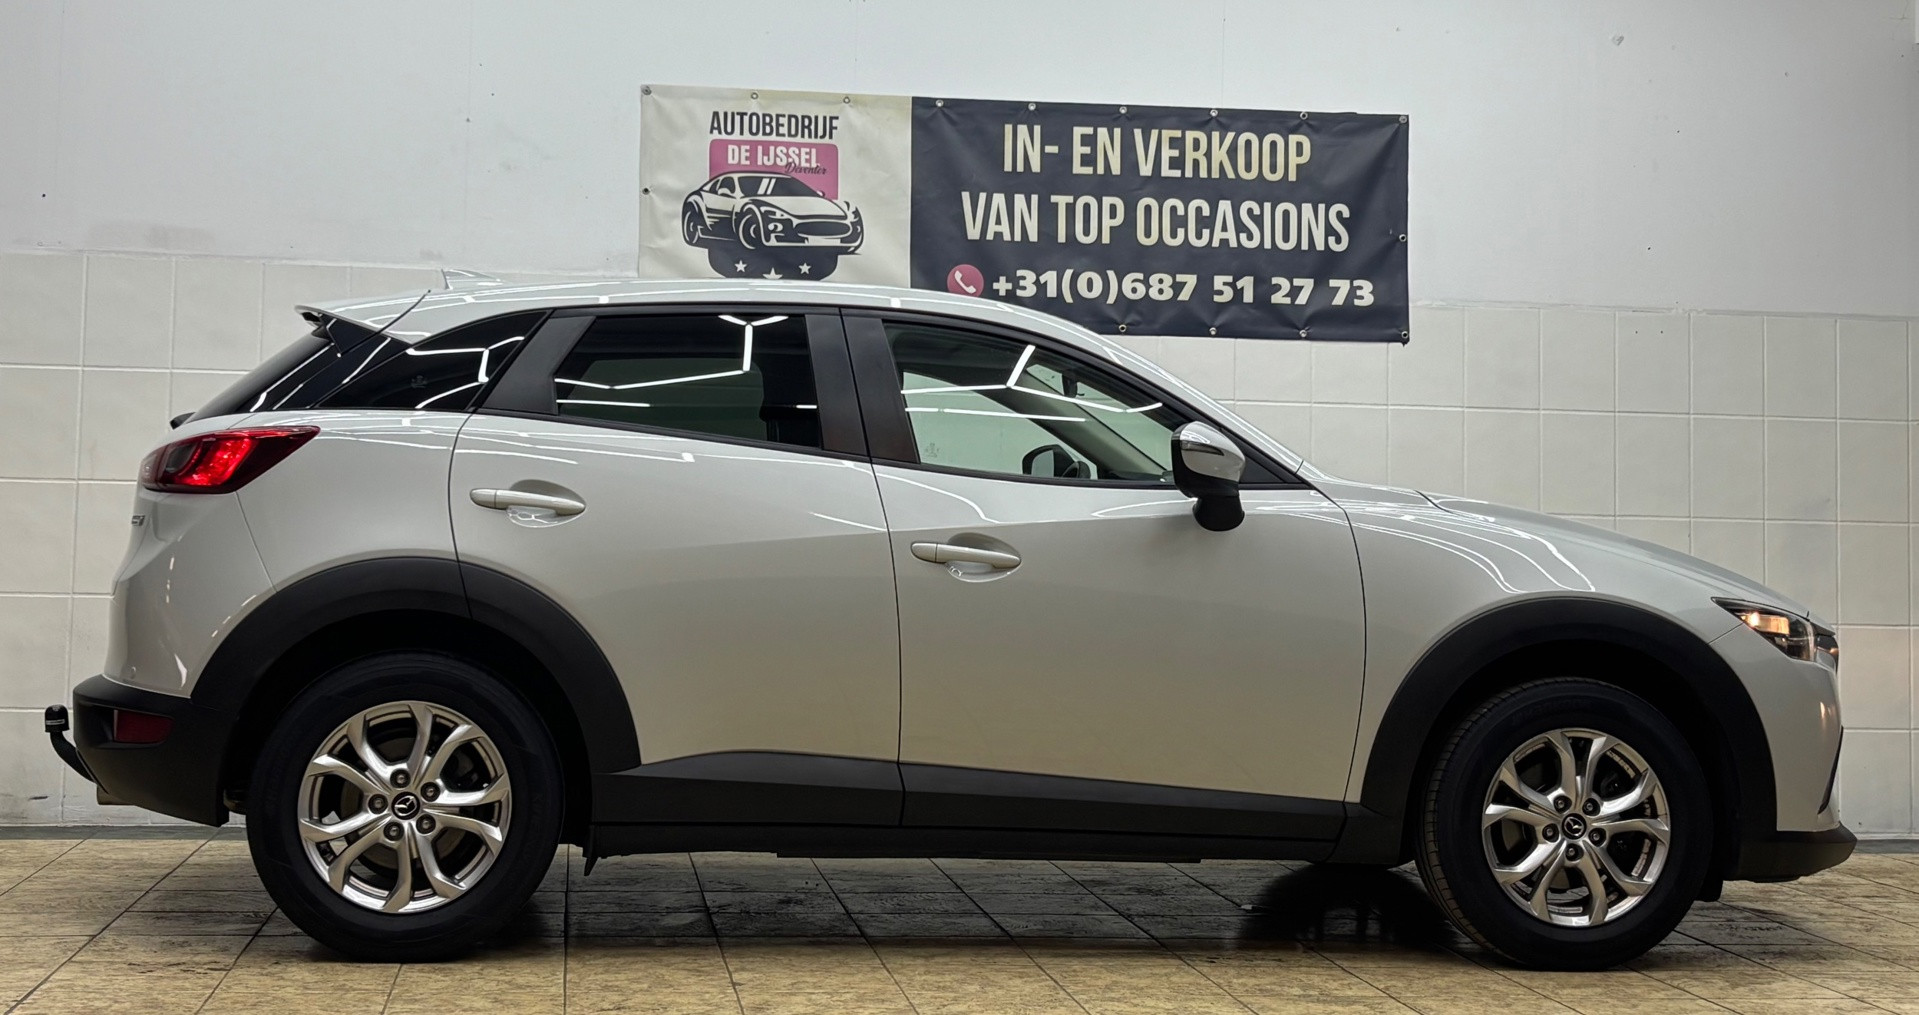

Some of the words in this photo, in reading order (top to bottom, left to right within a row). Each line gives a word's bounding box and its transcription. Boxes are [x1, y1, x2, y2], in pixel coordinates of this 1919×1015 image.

[710, 111, 839, 139] AUTOBEDRIJF
[728, 144, 750, 165] DE
[757, 145, 820, 168] IJSSEL
[1003, 124, 1059, 173] IN-
[1072, 127, 1121, 175] EN
[1134, 128, 1311, 182] VERKOOP
[961, 191, 1038, 242] VAN
[1050, 195, 1125, 244] TOP
[1136, 197, 1350, 252] OCCASIONS
[992, 269, 1197, 305] +31(0)687
[1212, 276, 1254, 303] 51
[1271, 276, 1314, 305] 27
[1329, 279, 1375, 307] 73
